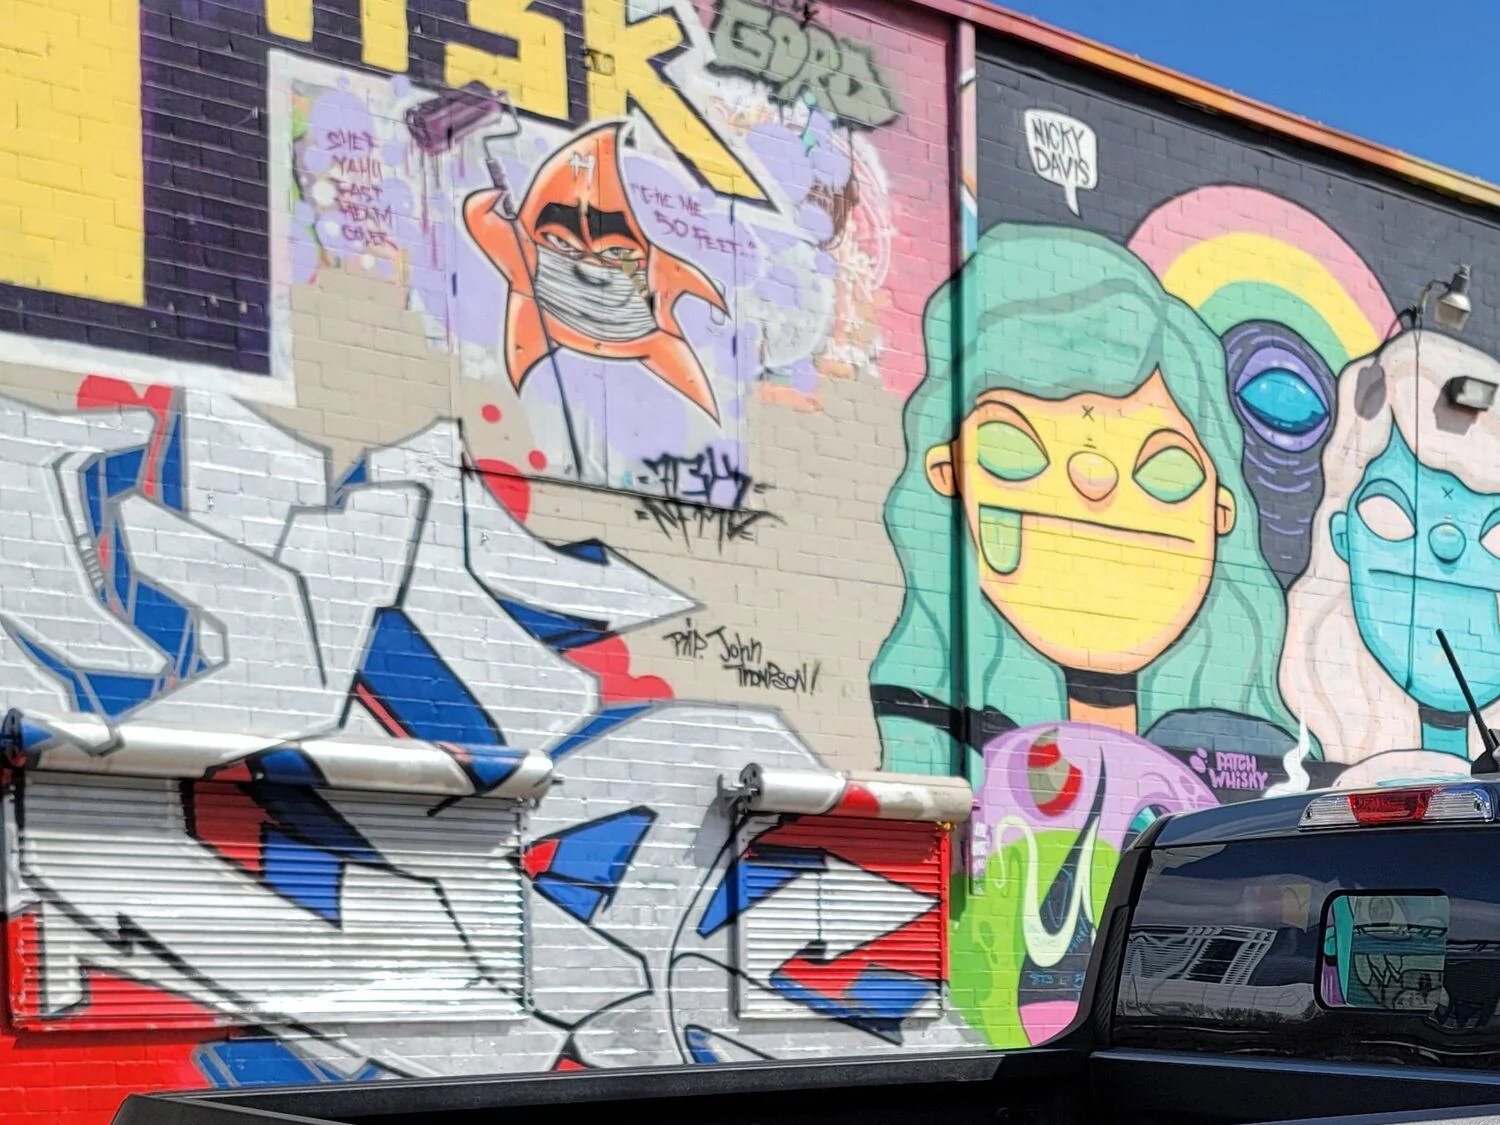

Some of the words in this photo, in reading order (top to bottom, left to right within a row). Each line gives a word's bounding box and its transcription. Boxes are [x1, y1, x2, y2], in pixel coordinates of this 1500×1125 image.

[1031, 118, 1084, 158] NICKY
[1034, 147, 1089, 185] DAVIS
[653, 210, 690, 239] 50
[706, 626, 762, 664] John
